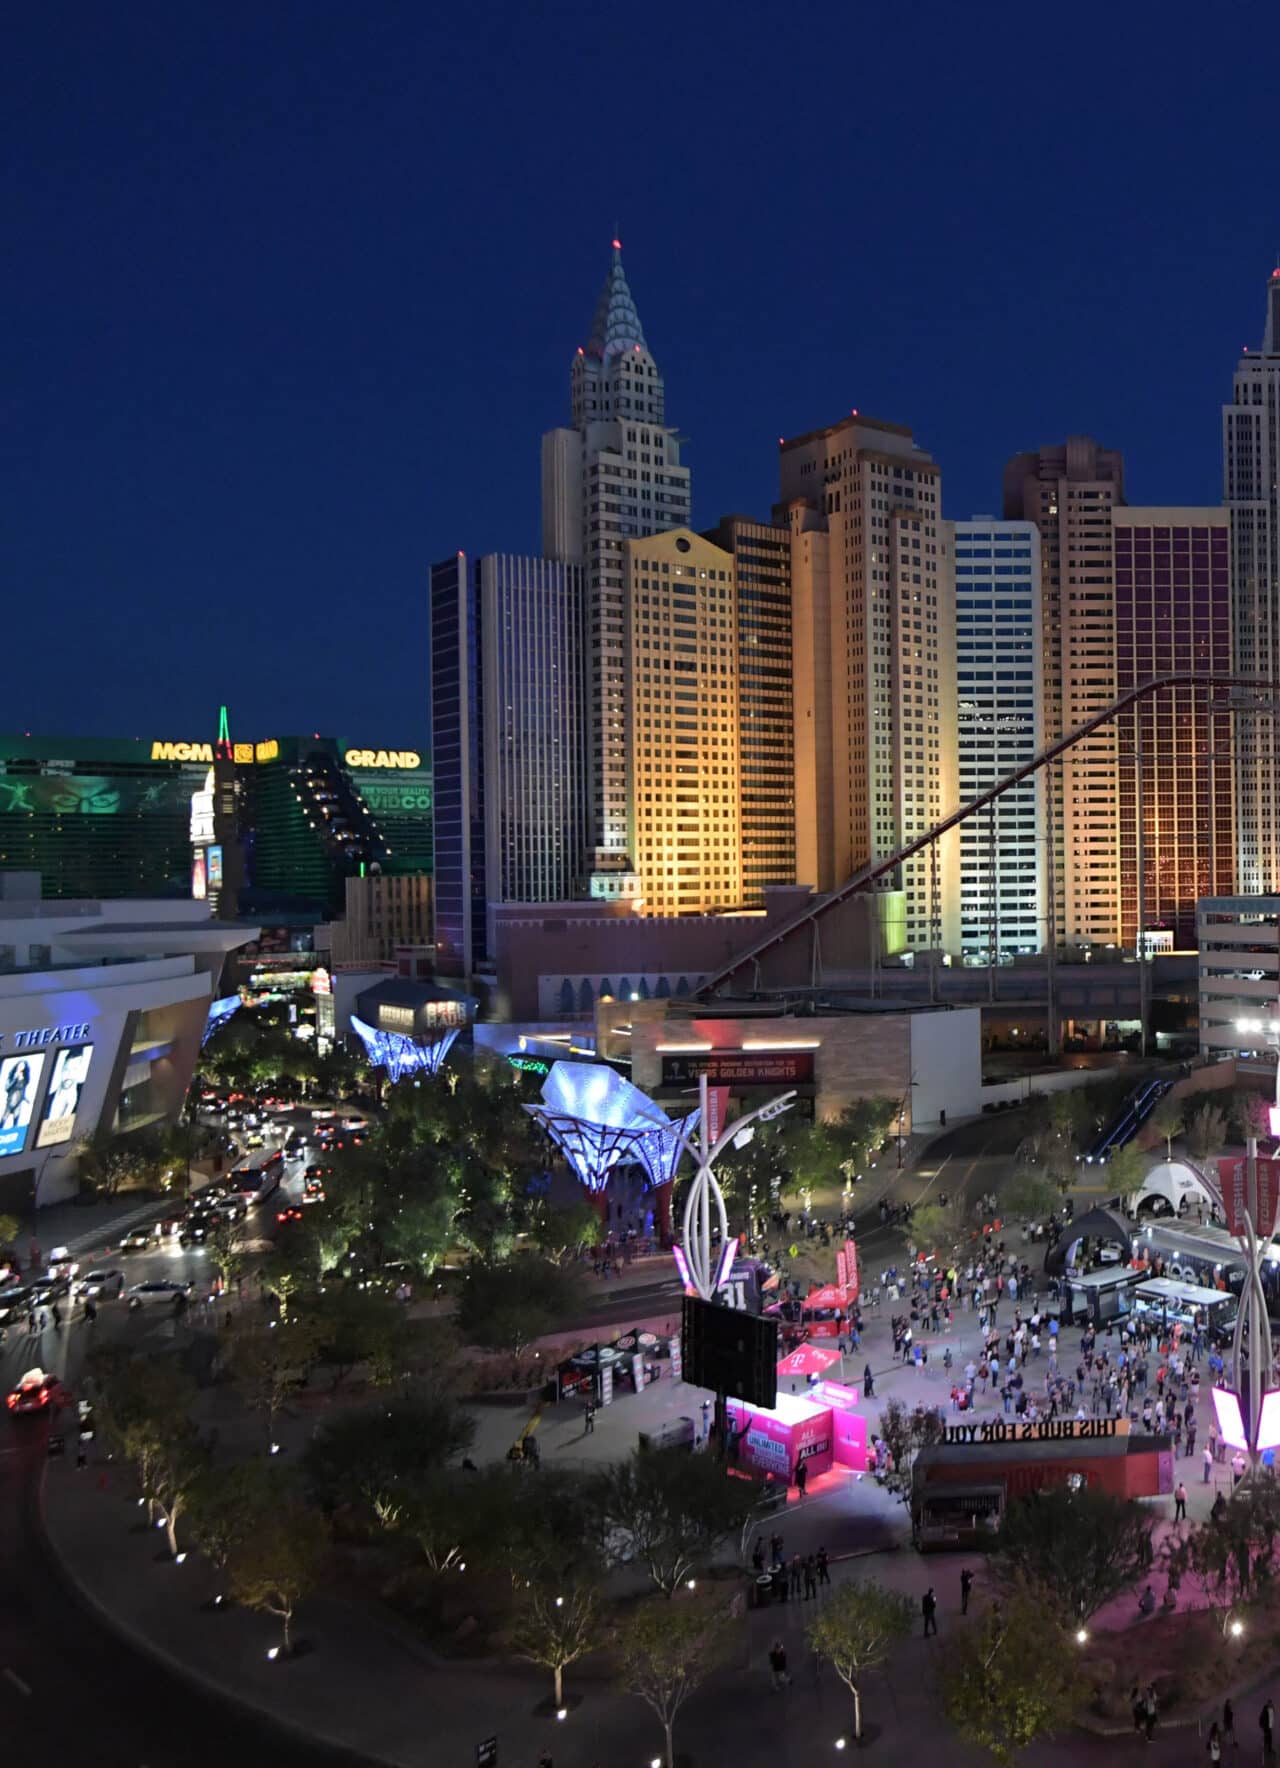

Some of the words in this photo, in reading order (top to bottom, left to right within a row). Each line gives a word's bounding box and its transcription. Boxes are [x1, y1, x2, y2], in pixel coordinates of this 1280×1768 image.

[151, 741, 213, 761] MGM
[345, 749, 421, 769] GRAND
[15, 1023, 90, 1047] THEATER
[688, 1068, 718, 1078] VEGAS
[720, 1068, 754, 1078] GOLDEN
[758, 1067, 796, 1077] KNIGHTS
[710, 1090, 718, 1137] TOSHIBA
[1232, 1161, 1244, 1228] TOSHIBA
[749, 1433, 784, 1454] UNLIMITED
[800, 1445, 817, 1459] ALL
